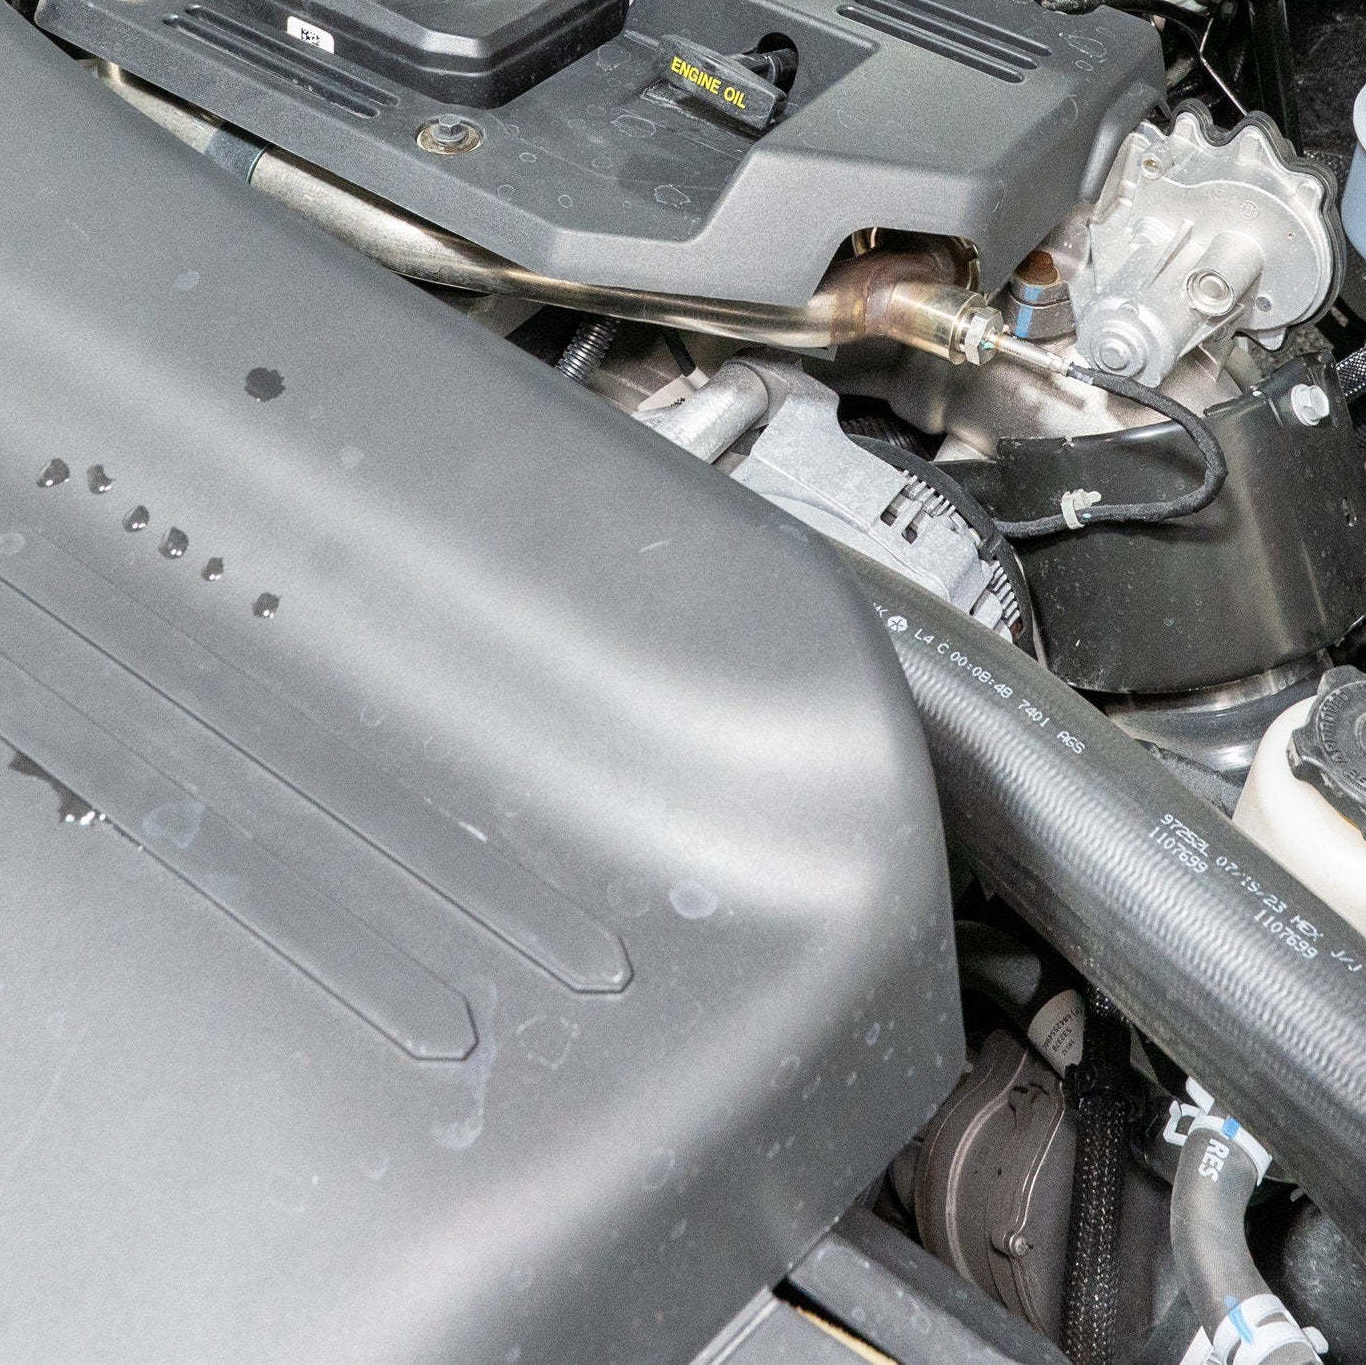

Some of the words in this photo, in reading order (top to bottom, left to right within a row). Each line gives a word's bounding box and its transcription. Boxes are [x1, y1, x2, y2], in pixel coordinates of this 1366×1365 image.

[670, 55, 722, 95] ENGINE
[723, 86, 746, 109] OIL
[914, 628, 935, 645] L4
[937, 642, 950, 655] C
[949, 651, 1014, 700] 00:08:48
[1018, 699, 1050, 728] 7401
[1056, 730, 1086, 755] AGS
[1148, 826, 1209, 874] 1107699
[1253, 909, 1319, 959] 1107699
[1290, 914, 1325, 942] MEX
[1197, 1138, 1230, 1183] RES
